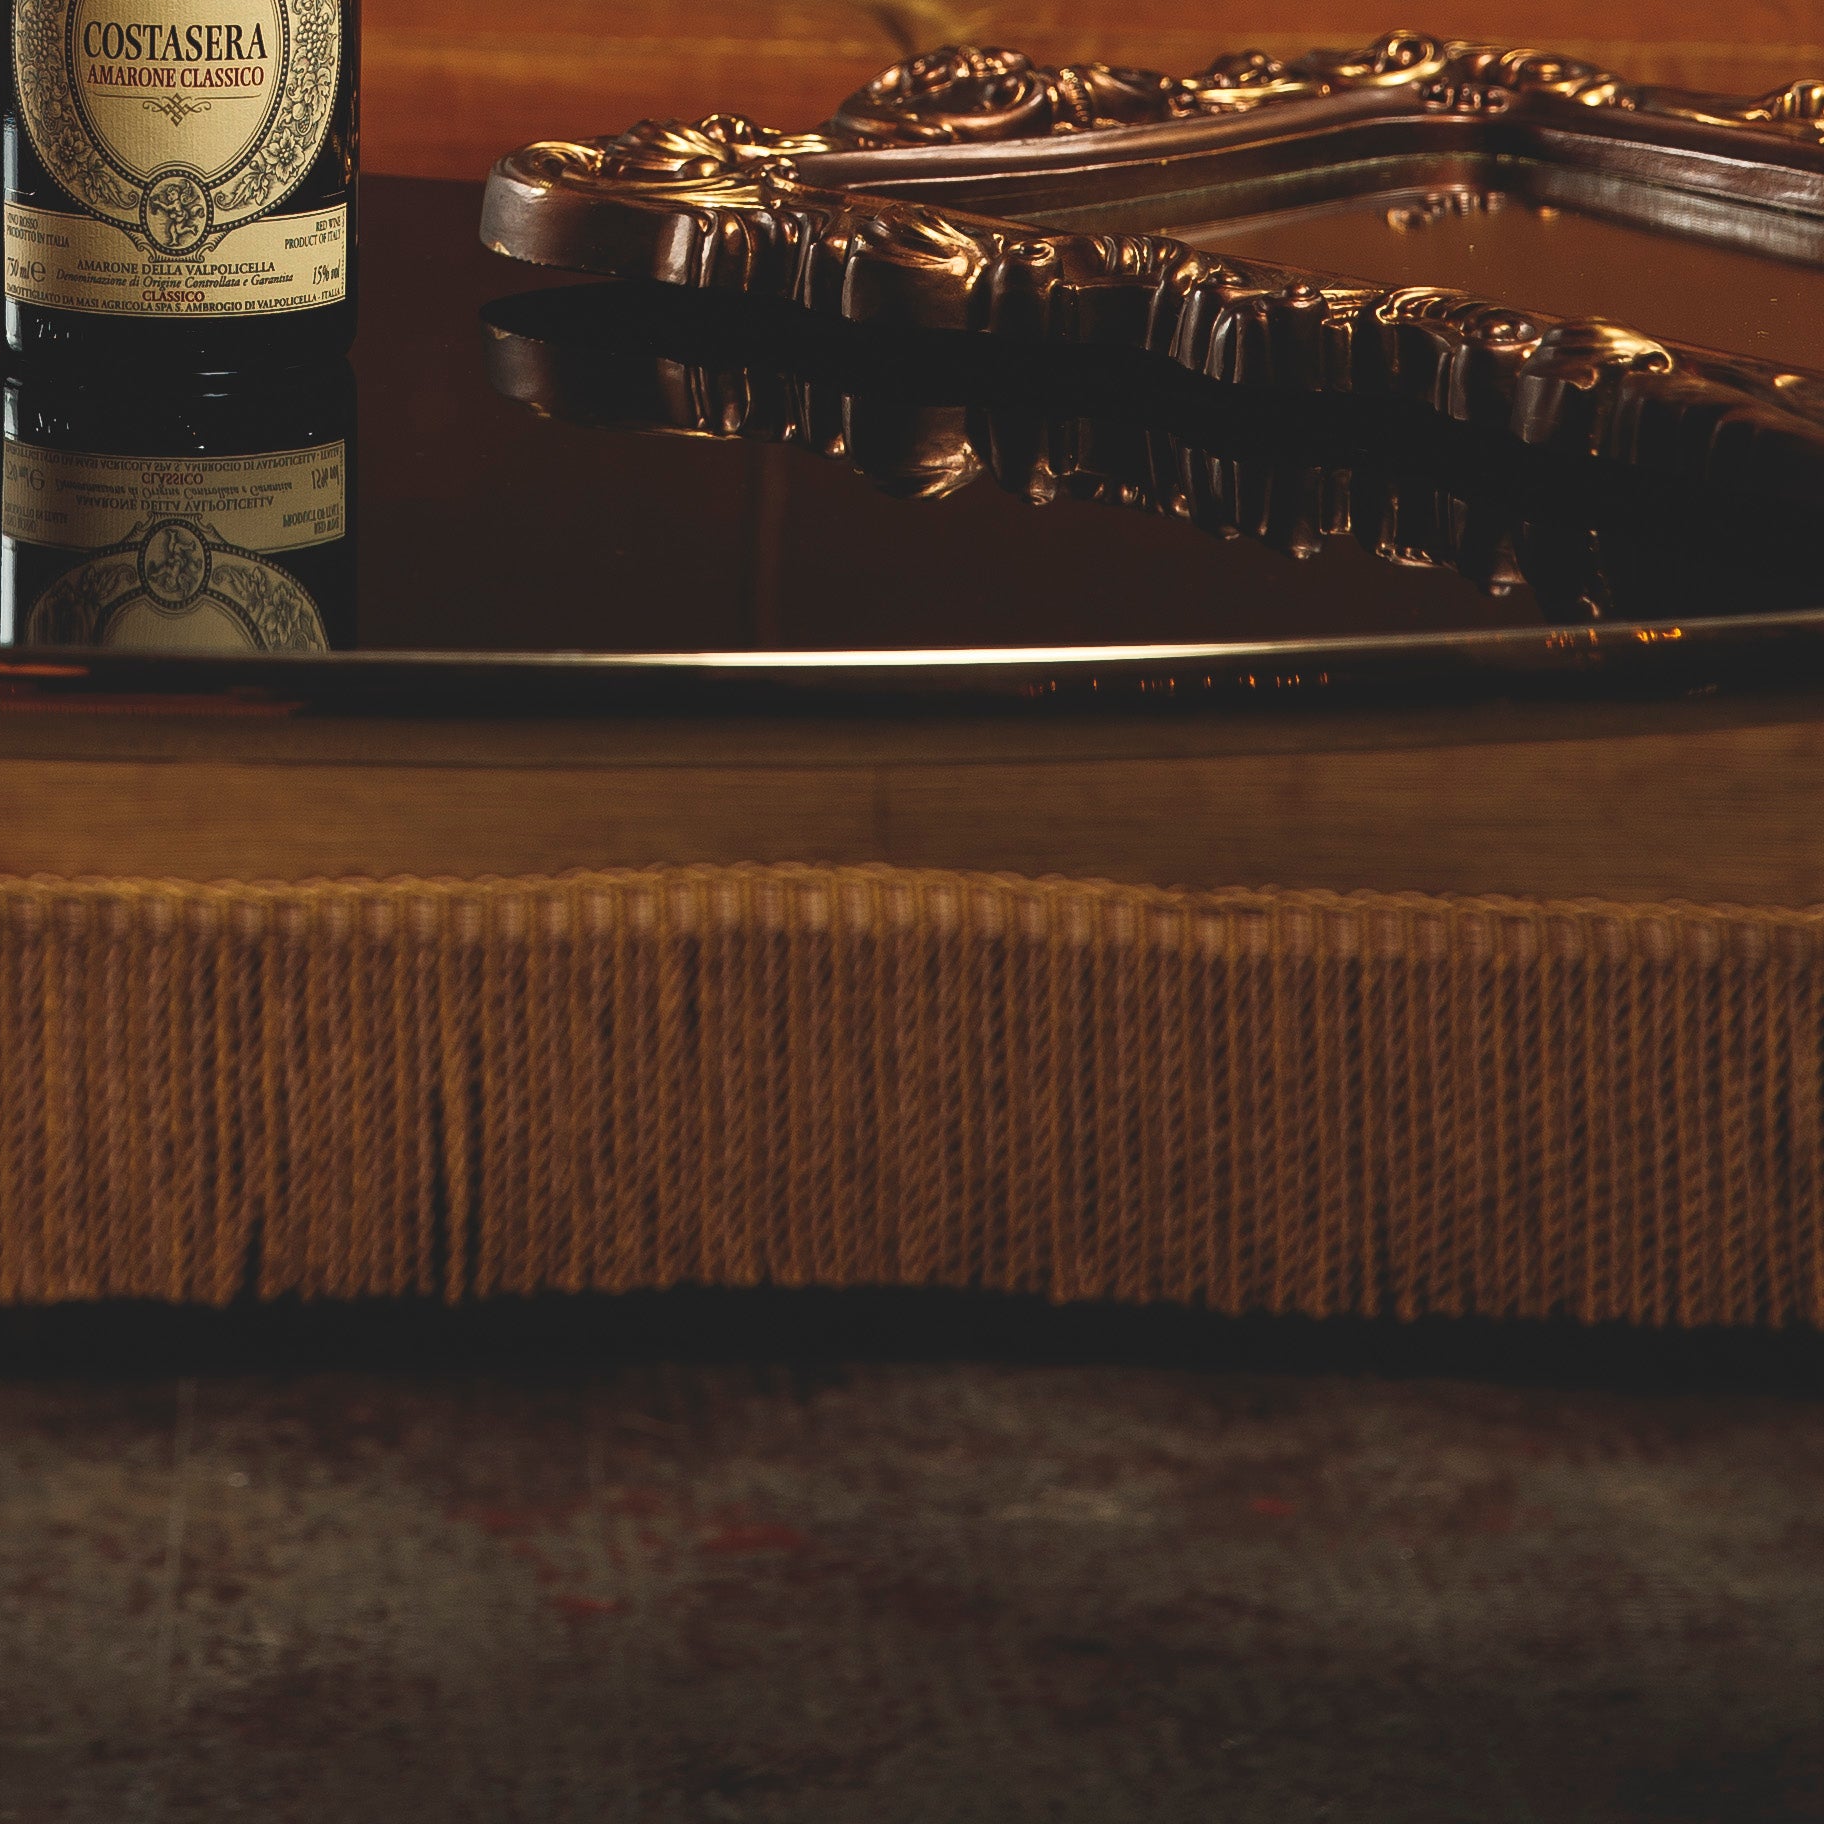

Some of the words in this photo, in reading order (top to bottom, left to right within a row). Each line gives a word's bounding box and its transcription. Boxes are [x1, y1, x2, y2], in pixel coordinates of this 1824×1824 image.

[83, 20, 268, 63] COSTASERA
[87, 66, 178, 88] AMARONE
[179, 66, 265, 87] CLASSICO
[19, 215, 39, 230] ROSSO
[315, 219, 327, 231] RED
[37, 232, 44, 244] IN
[46, 233, 70, 248] ITALIA
[284, 235, 318, 250] PRODUCT
[318, 232, 327, 245] OF
[20, 260, 30, 279] ml
[77, 259, 138, 274] AMARONE
[142, 263, 183, 276] DELLA
[185, 261, 276, 276] VALPOLICELLA
[313, 264, 330, 285] 15%
[56, 268, 127, 286] Denominazione
[129, 274, 140, 287] di
[142, 275, 182, 291] Origine
[184, 275, 241, 289] Controllata
[242, 279, 249, 287] e
[251, 272, 294, 286] Garantita
[63, 295, 75, 305] DA
[76, 296, 99, 308] MASI
[101, 299, 153, 312] AGRICOLA
[155, 302, 173, 313] SPA
[174, 302, 184, 313] S.
[185, 301, 243, 313] AMBROGIO
[244, 300, 256, 311] DI
[257, 293, 316, 309] VALPOLICELLA
[321, 287, 340, 300] ITALIA
[142, 290, 206, 303] CLASSICO
